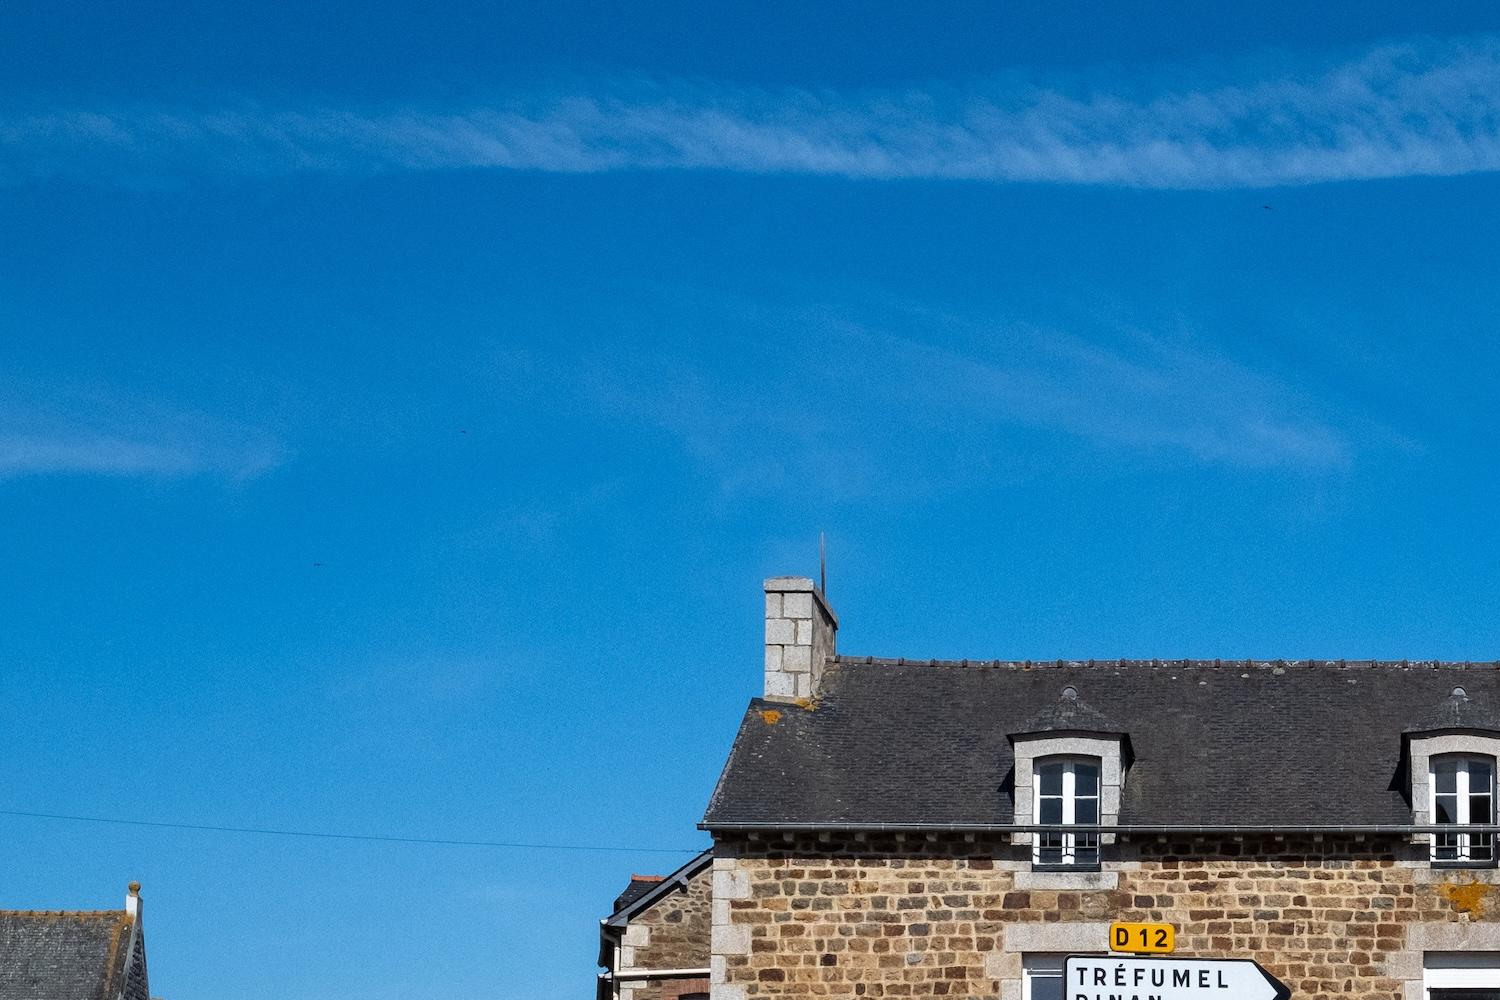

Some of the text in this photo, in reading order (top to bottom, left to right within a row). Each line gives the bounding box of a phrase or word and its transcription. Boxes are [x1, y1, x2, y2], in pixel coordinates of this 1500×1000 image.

[1116, 928, 1168, 947] D 12
[1076, 964, 1229, 988] TRÉFUMEL
